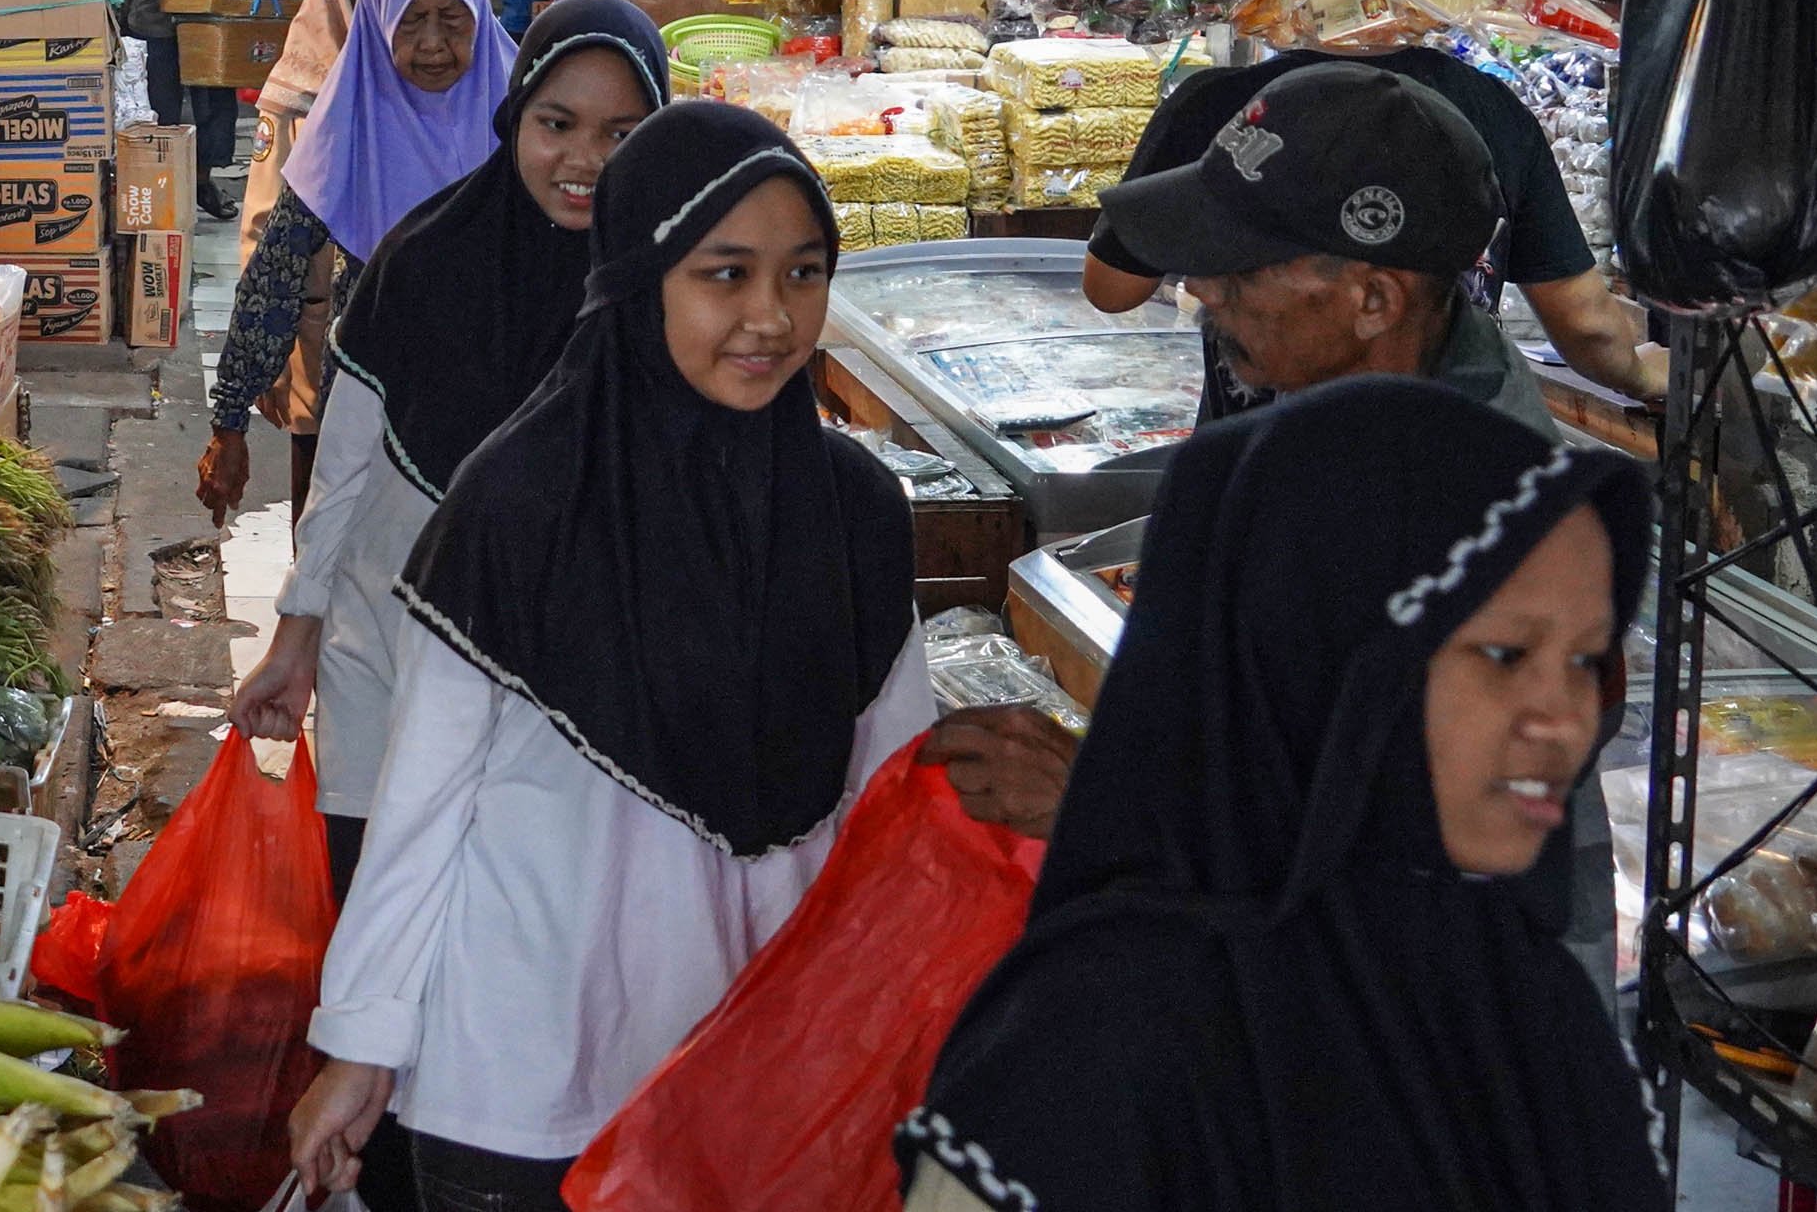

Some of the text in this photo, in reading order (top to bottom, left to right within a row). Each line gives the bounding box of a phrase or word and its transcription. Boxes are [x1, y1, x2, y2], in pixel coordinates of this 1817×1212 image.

[126, 185, 140, 226] Snow
[140, 187, 153, 225] Cake
[143, 261, 156, 297] WOW
